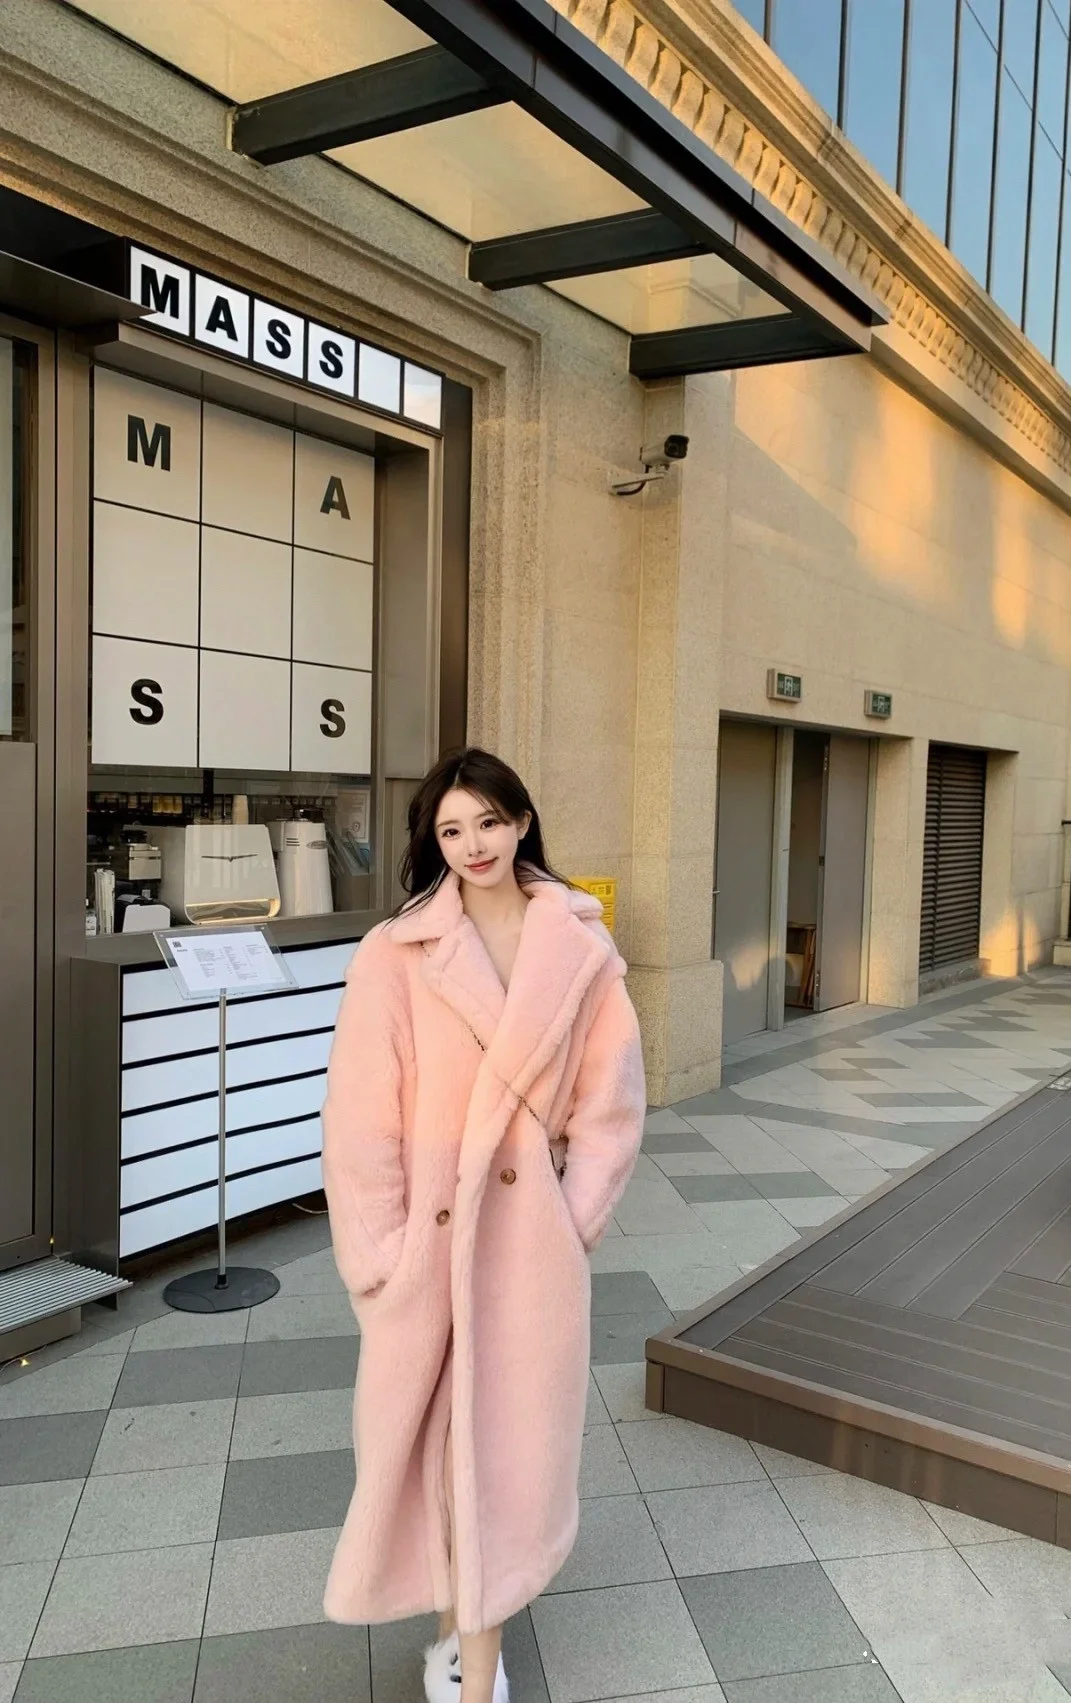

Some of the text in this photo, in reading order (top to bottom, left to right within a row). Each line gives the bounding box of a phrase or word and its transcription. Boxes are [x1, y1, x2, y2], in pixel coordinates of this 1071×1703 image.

[141, 264, 343, 379] MASS
[127, 414, 351, 520] M A
[129, 678, 346, 738] S S
